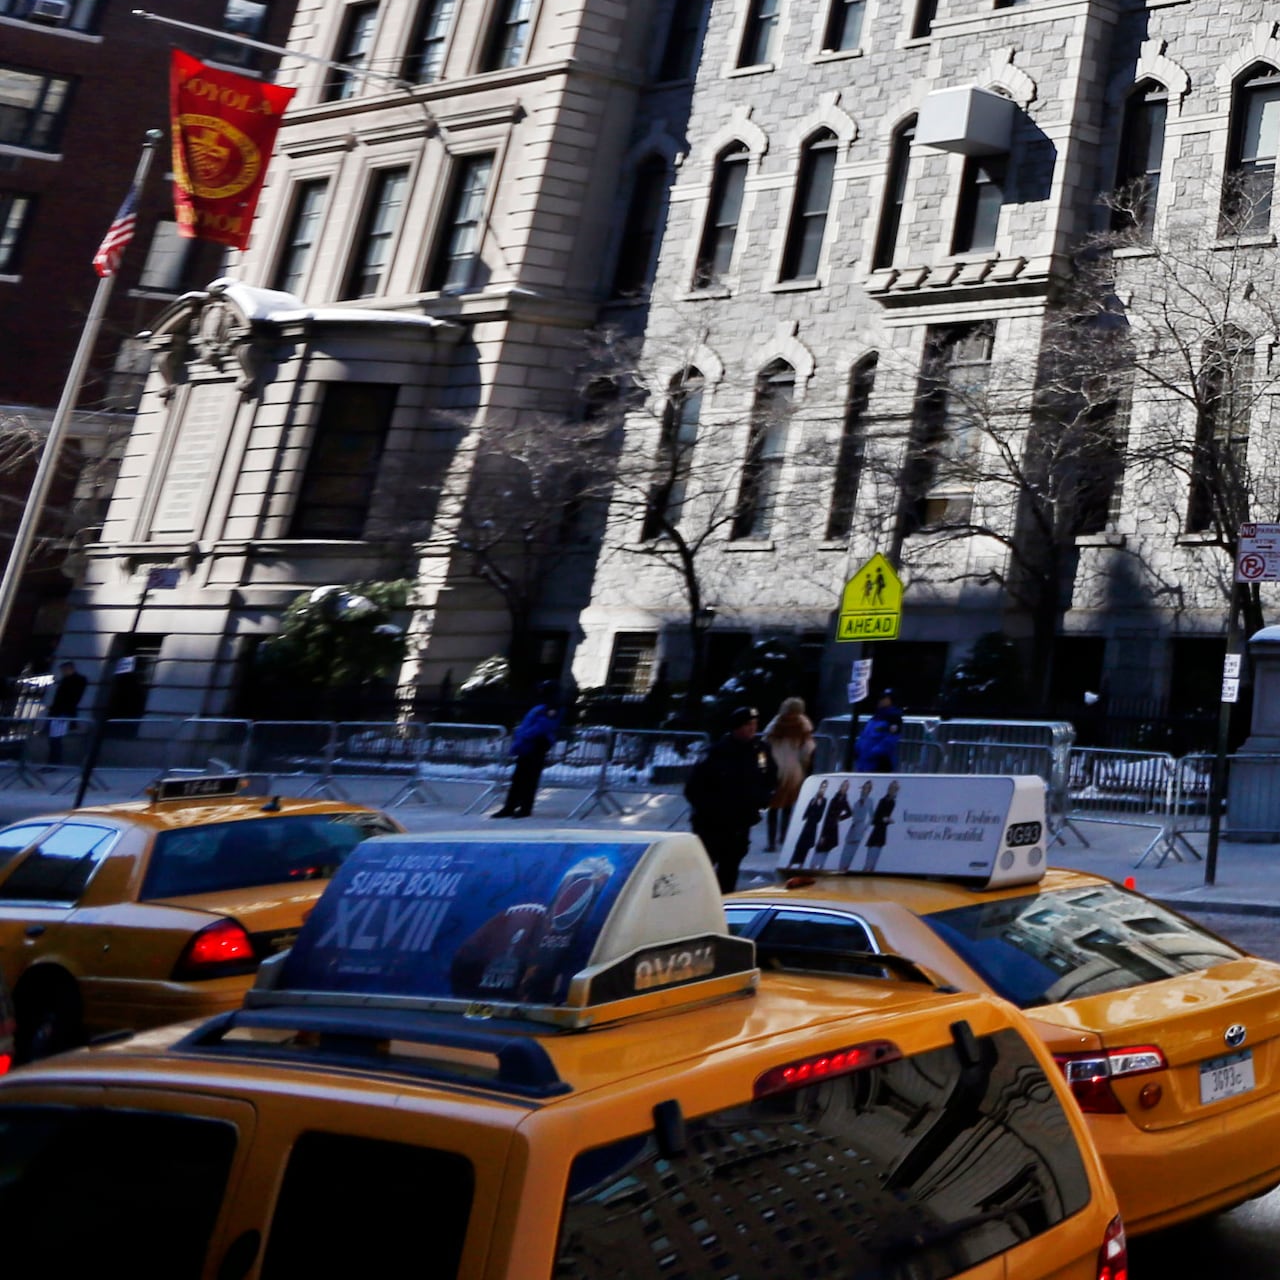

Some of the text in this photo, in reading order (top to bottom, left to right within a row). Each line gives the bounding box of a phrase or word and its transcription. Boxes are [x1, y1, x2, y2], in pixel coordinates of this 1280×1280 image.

[1241, 525, 1256, 536] NO
[844, 618, 892, 634] AHEAD
[344, 871, 464, 896] SUPER BOWL
[315, 897, 453, 952] XLVIII
